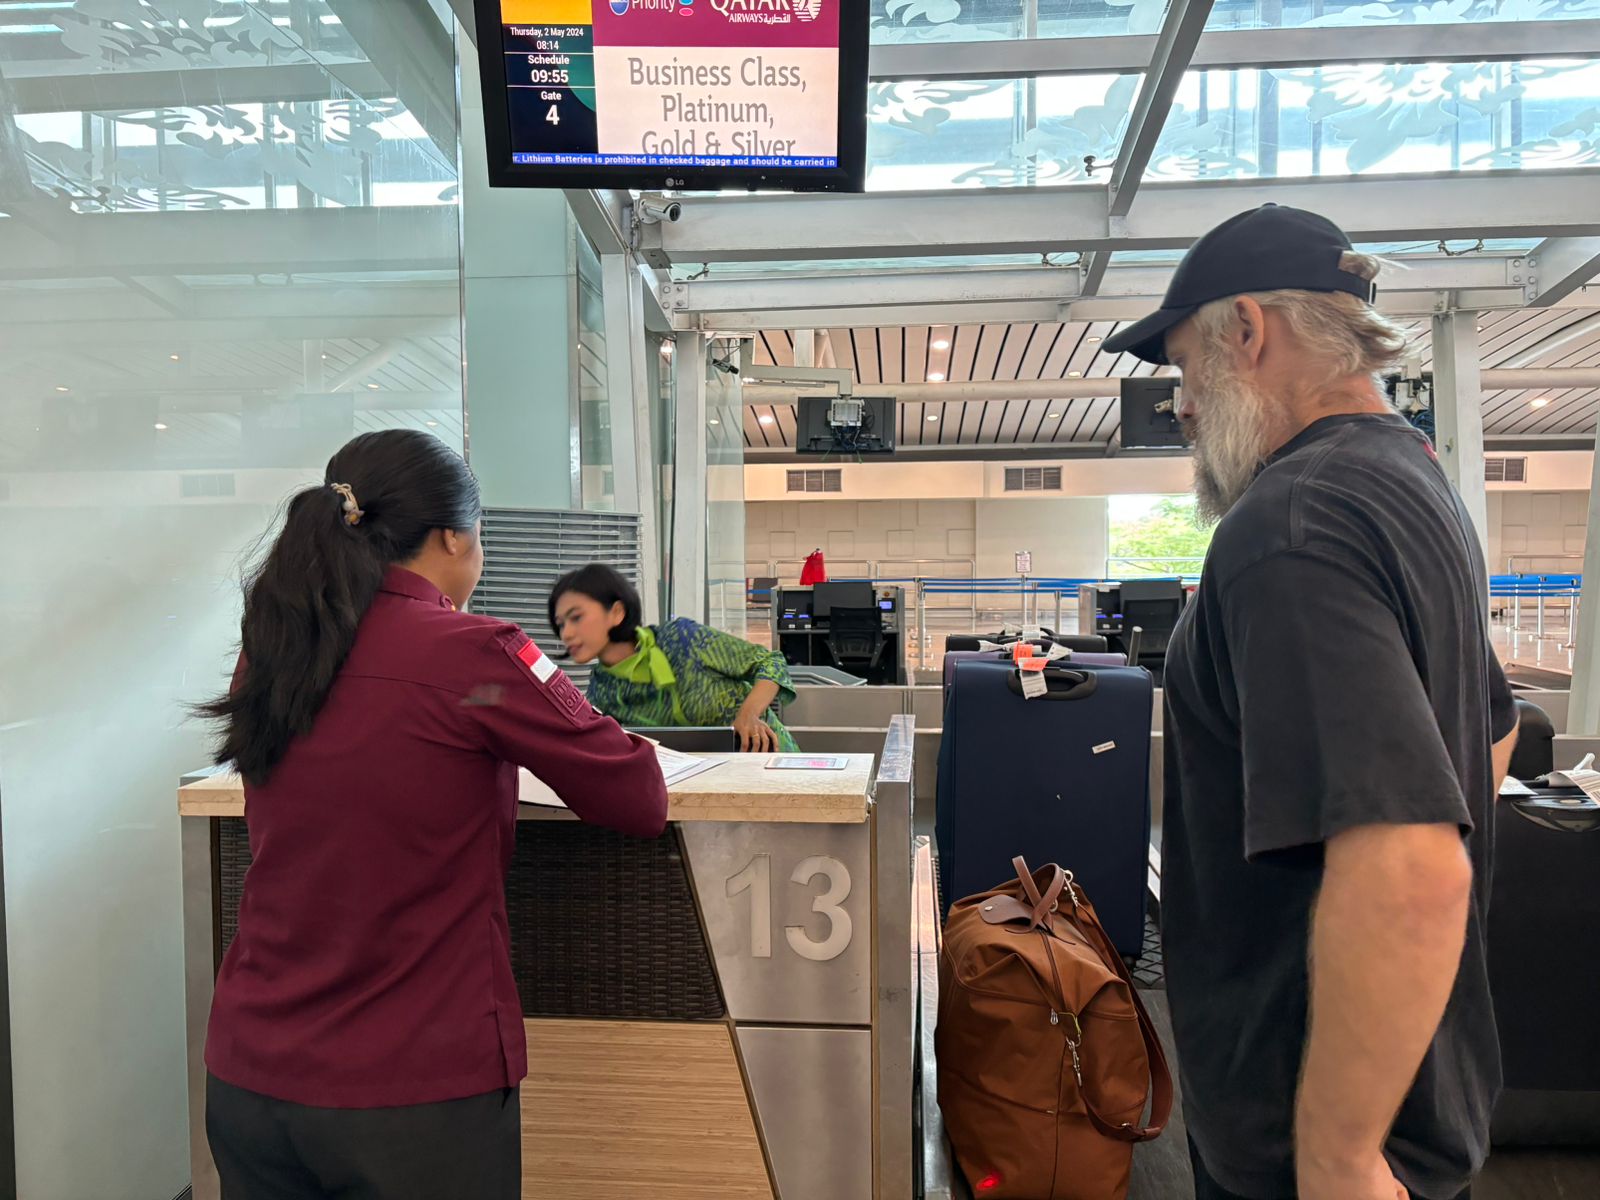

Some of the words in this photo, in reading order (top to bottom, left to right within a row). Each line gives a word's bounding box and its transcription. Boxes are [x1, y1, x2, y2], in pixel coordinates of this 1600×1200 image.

[632, 0, 675, 12] Priority
[728, 13, 762, 23] AIRWAYS
[510, 27, 543, 38] Thursday,
[544, 28, 549, 36] 2
[550, 28, 565, 38] May
[566, 28, 584, 36] 2024
[536, 41, 559, 50] 08:14
[528, 55, 570, 64] Schedule
[531, 70, 569, 83] 09:55
[628, 57, 731, 86] Business
[741, 56, 806, 92] Class,
[540, 91, 562, 100] Gate
[545, 104, 560, 125] 4
[661, 93, 774, 128] Platinum,
[642, 130, 695, 155] Gold
[705, 132, 721, 155] &
[731, 131, 797, 156] Silver
[522, 155, 553, 163] Lithium
[556, 155, 592, 164] Batteries
[595, 156, 603, 164] is
[605, 156, 646, 165] prohibited
[649, 156, 657, 164] in
[659, 156, 693, 165] checked
[695, 157, 731, 166] baggage
[734, 157, 749, 165] and
[751, 157, 779, 165] should
[782, 157, 792, 165] be
[794, 158, 824, 166] carried
[827, 158, 835, 166] in
[725, 853, 853, 962] 13
